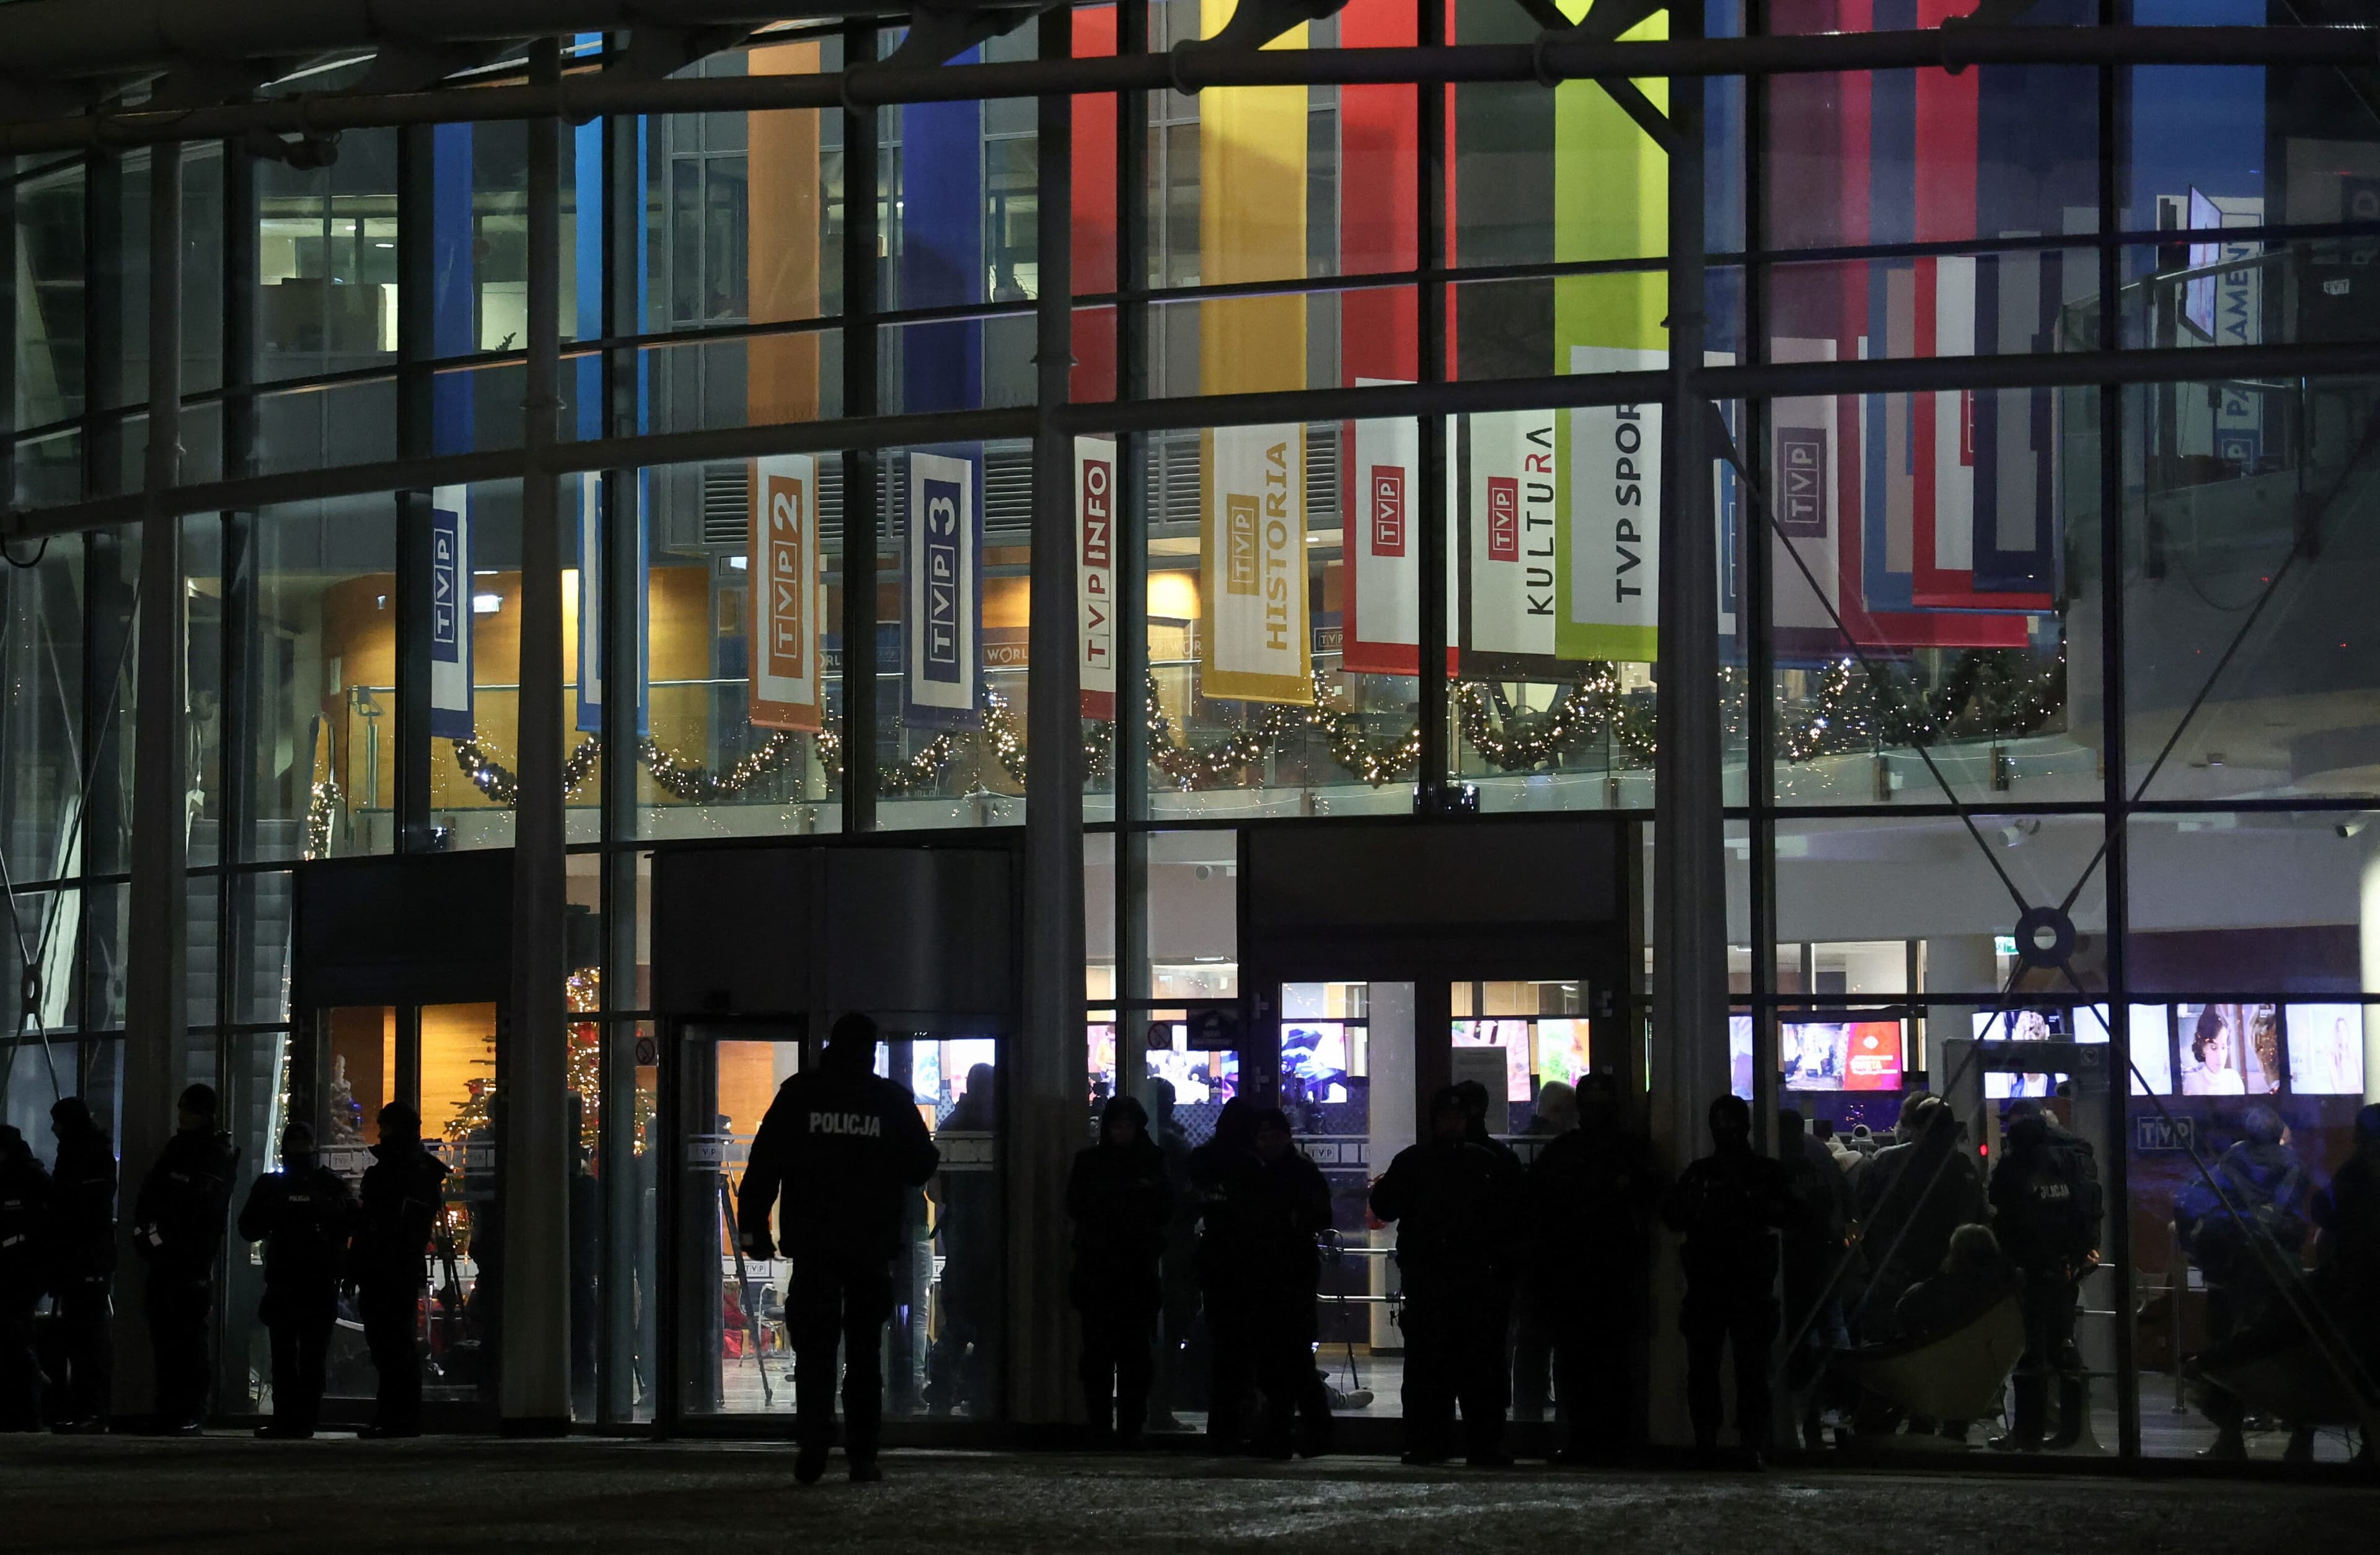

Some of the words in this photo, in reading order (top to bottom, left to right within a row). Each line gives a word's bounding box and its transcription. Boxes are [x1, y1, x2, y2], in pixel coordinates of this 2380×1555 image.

[1615, 402, 1642, 506] SPOR
[1789, 446, 1814, 519] TVP
[774, 492, 798, 535] 2
[929, 496, 955, 536] 3
[1086, 466, 1107, 560] INFO
[1235, 512, 1251, 578] TVP
[1266, 441, 1288, 650] HISTORIA
[1379, 481, 1397, 542] TVP
[1495, 491, 1511, 547] TVP
[1525, 427, 1554, 615] KULTURA
[436, 536, 451, 637] TVP
[1615, 518, 1642, 603] TVP
[777, 548, 794, 651] TVP
[933, 552, 952, 656] TVP
[1087, 573, 1106, 663] TVP
[987, 646, 1028, 663] WORL
[1320, 633, 1343, 645] TVP
[808, 1111, 881, 1138] POLICJA
[1310, 1148, 1333, 1158] TVP
